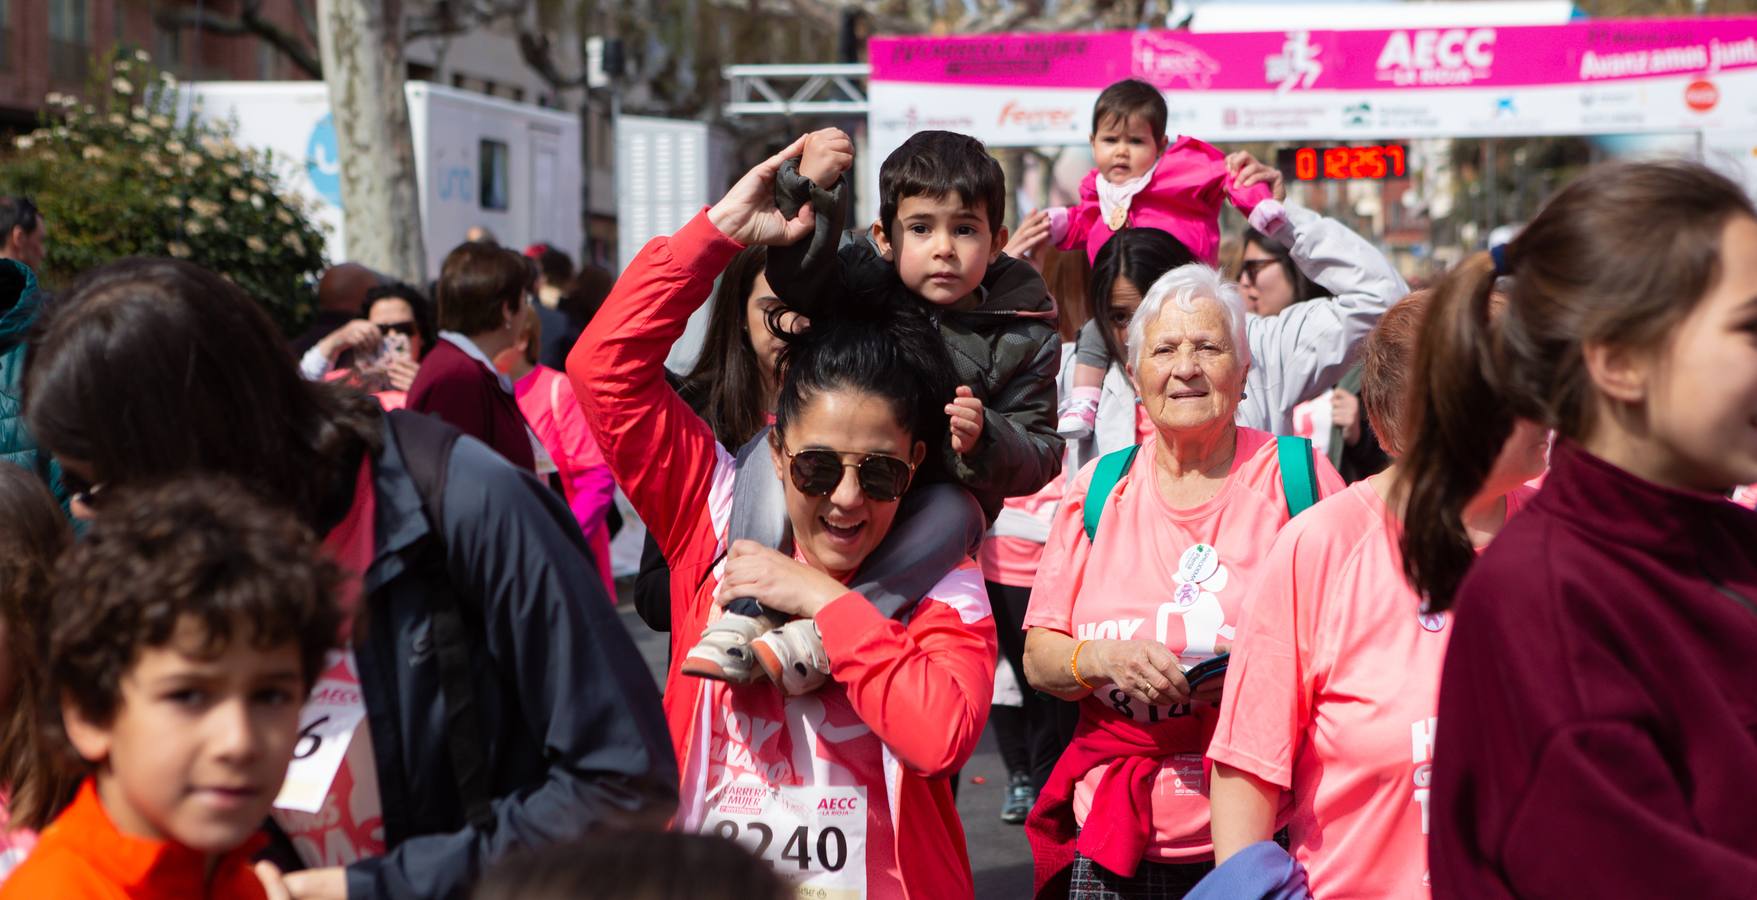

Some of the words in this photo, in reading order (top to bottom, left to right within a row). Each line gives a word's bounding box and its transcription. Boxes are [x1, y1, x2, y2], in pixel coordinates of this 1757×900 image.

[1376, 28, 1497, 70] AECC
[1077, 618, 1145, 640] HOY
[723, 783, 767, 798] CARRERA
[727, 795, 761, 808] MUJER
[817, 797, 857, 811] AECC
